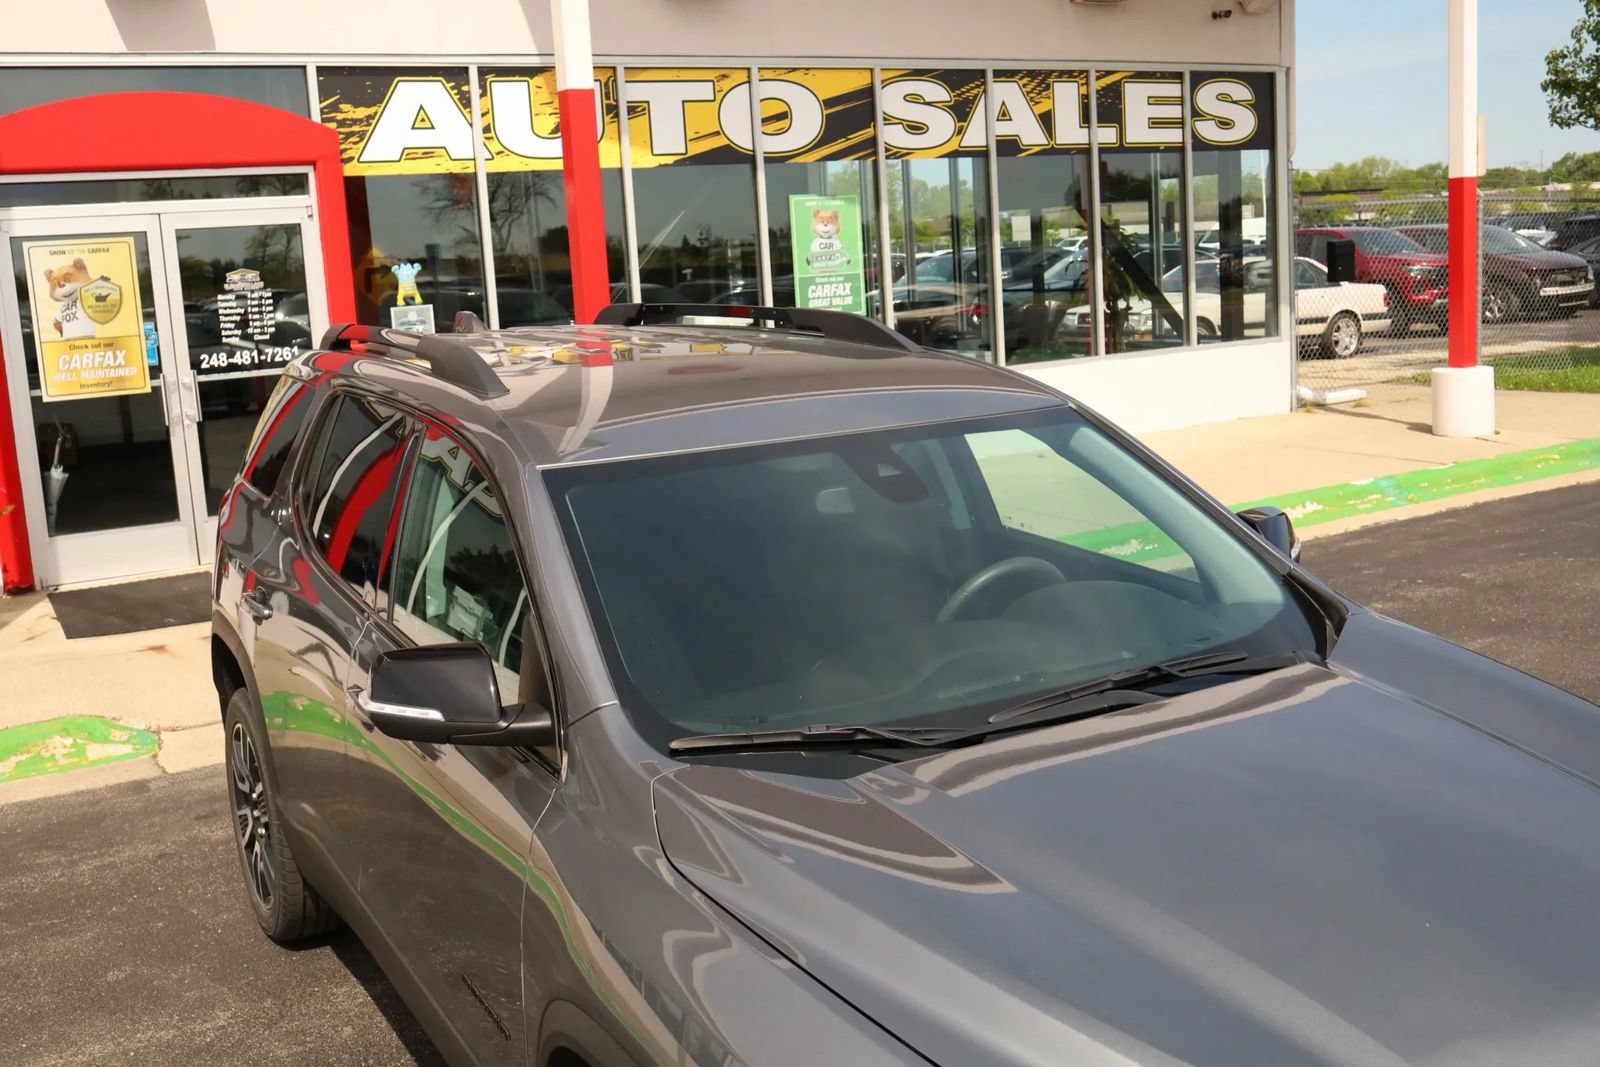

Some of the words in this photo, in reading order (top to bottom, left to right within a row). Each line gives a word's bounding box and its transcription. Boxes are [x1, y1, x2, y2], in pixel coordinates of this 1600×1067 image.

[357, 78, 825, 163] AUTO
[879, 77, 1258, 151] SALES
[808, 282, 852, 298] CARFAX
[61, 300, 78, 314] CAR
[809, 298, 830, 308] GREAT
[59, 350, 126, 369] CARFAX
[200, 346, 299, 368] 248-481-7261
[52, 372, 76, 382] WELL
[80, 367, 137, 379] MAINTAINED
